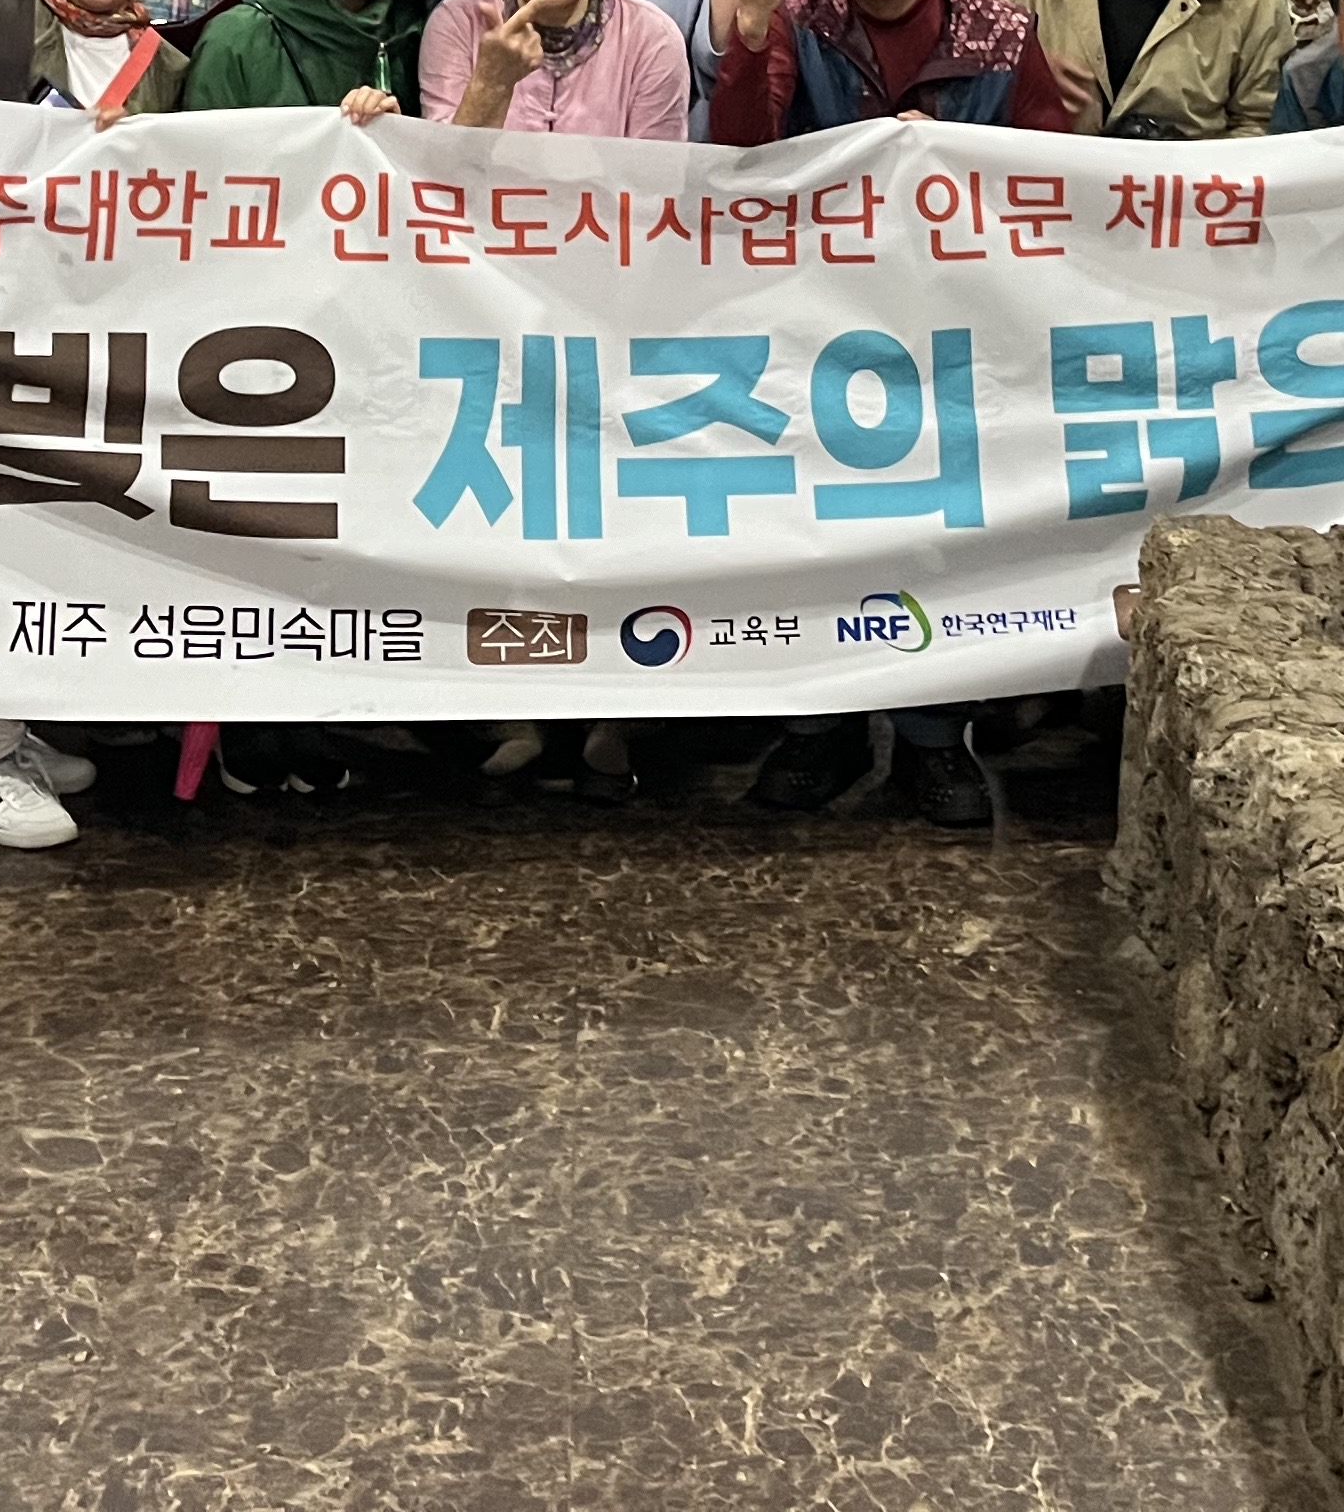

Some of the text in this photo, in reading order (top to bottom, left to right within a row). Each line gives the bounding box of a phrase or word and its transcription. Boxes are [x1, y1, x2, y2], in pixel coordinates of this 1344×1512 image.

[320, 172, 886, 268] 인문도시사업단
[916, 171, 1074, 262] 인문
[1107, 172, 1267, 250] 체험
[413, 328, 985, 542] 제주의
[8, 600, 109, 659] 제주
[130, 604, 426, 663] 성읍민속마을
[479, 612, 580, 663] 주최
[709, 615, 803, 647] 교육부
[837, 615, 910, 643] NRF
[940, 608, 1078, 637] 한국연구재단
